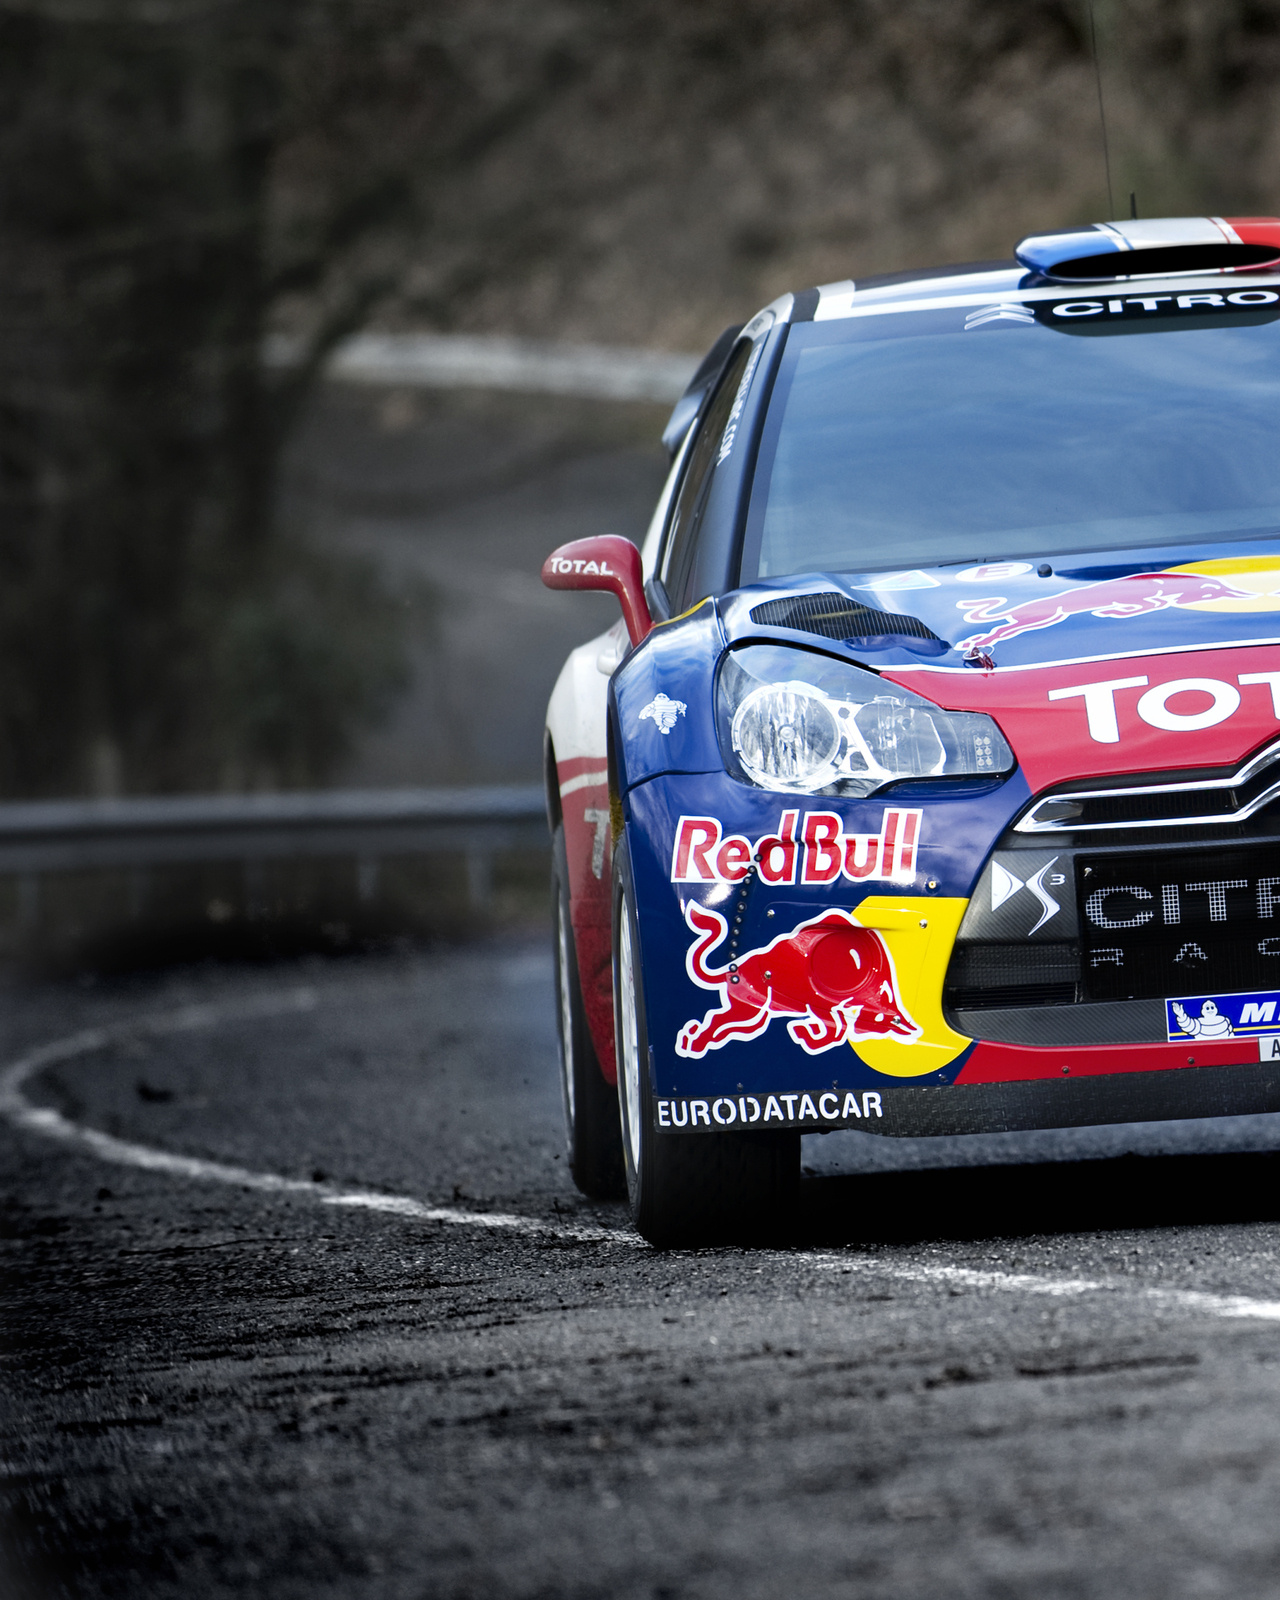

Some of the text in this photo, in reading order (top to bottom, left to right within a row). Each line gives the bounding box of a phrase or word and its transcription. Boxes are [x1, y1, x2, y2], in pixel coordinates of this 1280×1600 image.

[550, 556, 614, 576] TOTAL
[975, 564, 1014, 579] E
[657, 1092, 883, 1127] EURODATACAR
